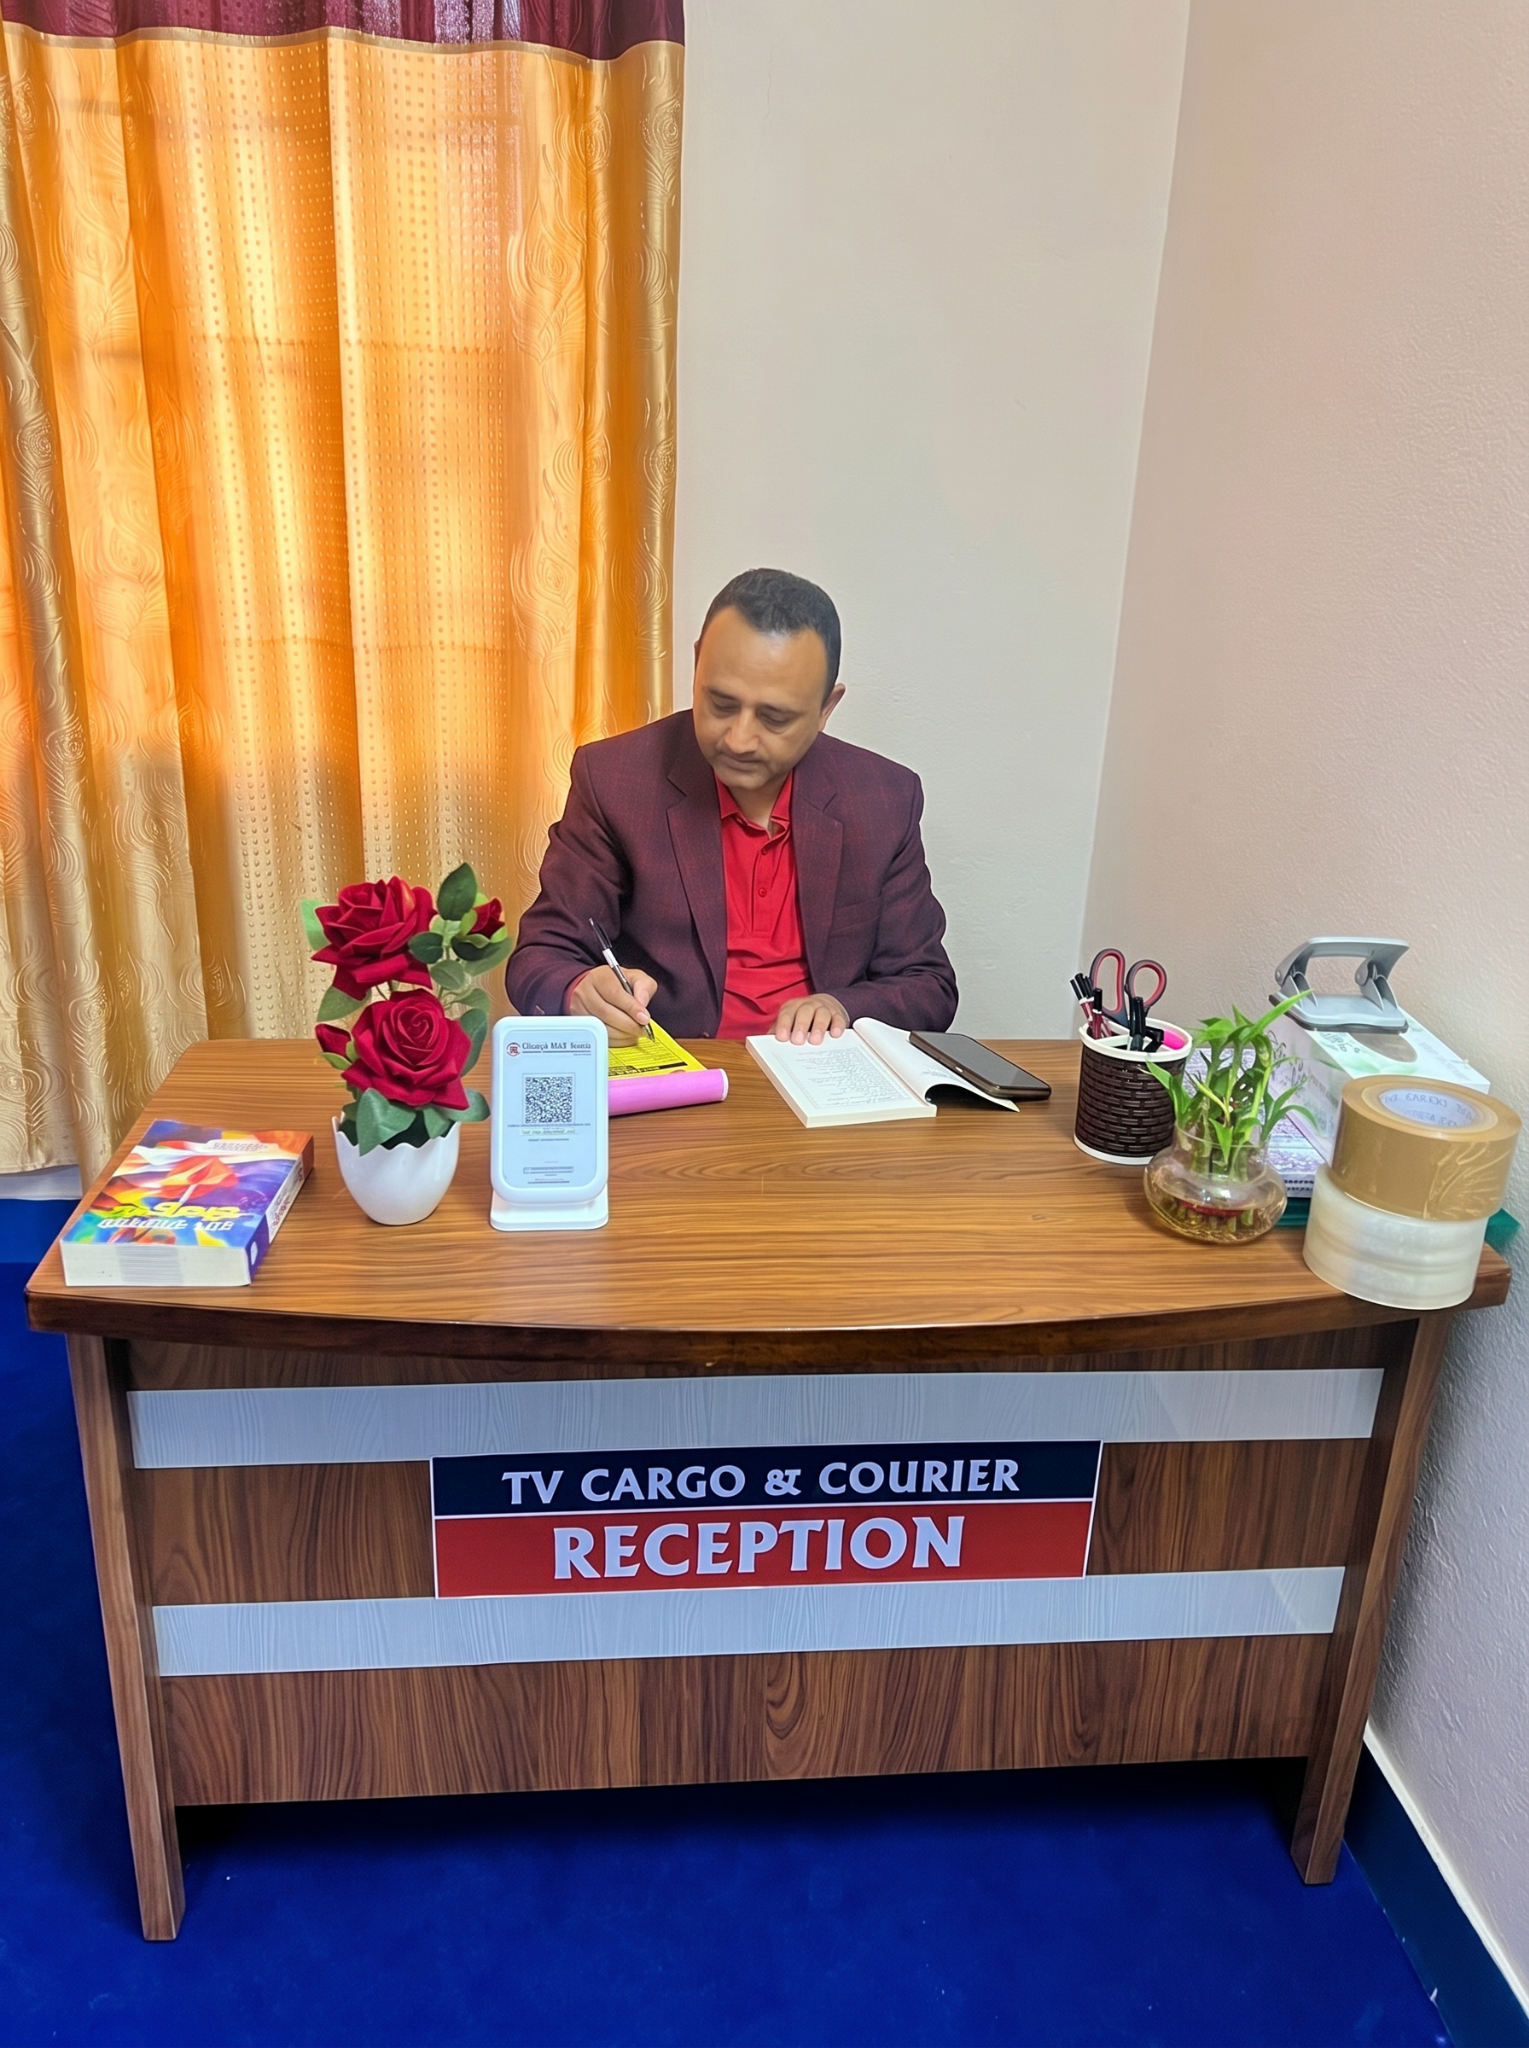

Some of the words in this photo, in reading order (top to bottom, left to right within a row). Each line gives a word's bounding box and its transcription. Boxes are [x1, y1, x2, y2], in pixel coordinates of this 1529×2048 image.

[501, 1470, 563, 1505] TV
[581, 1465, 746, 1502] CARGO
[764, 1468, 802, 1496] &
[818, 1459, 1020, 1495] COURIER
[553, 1515, 965, 1580] RECEPTION
